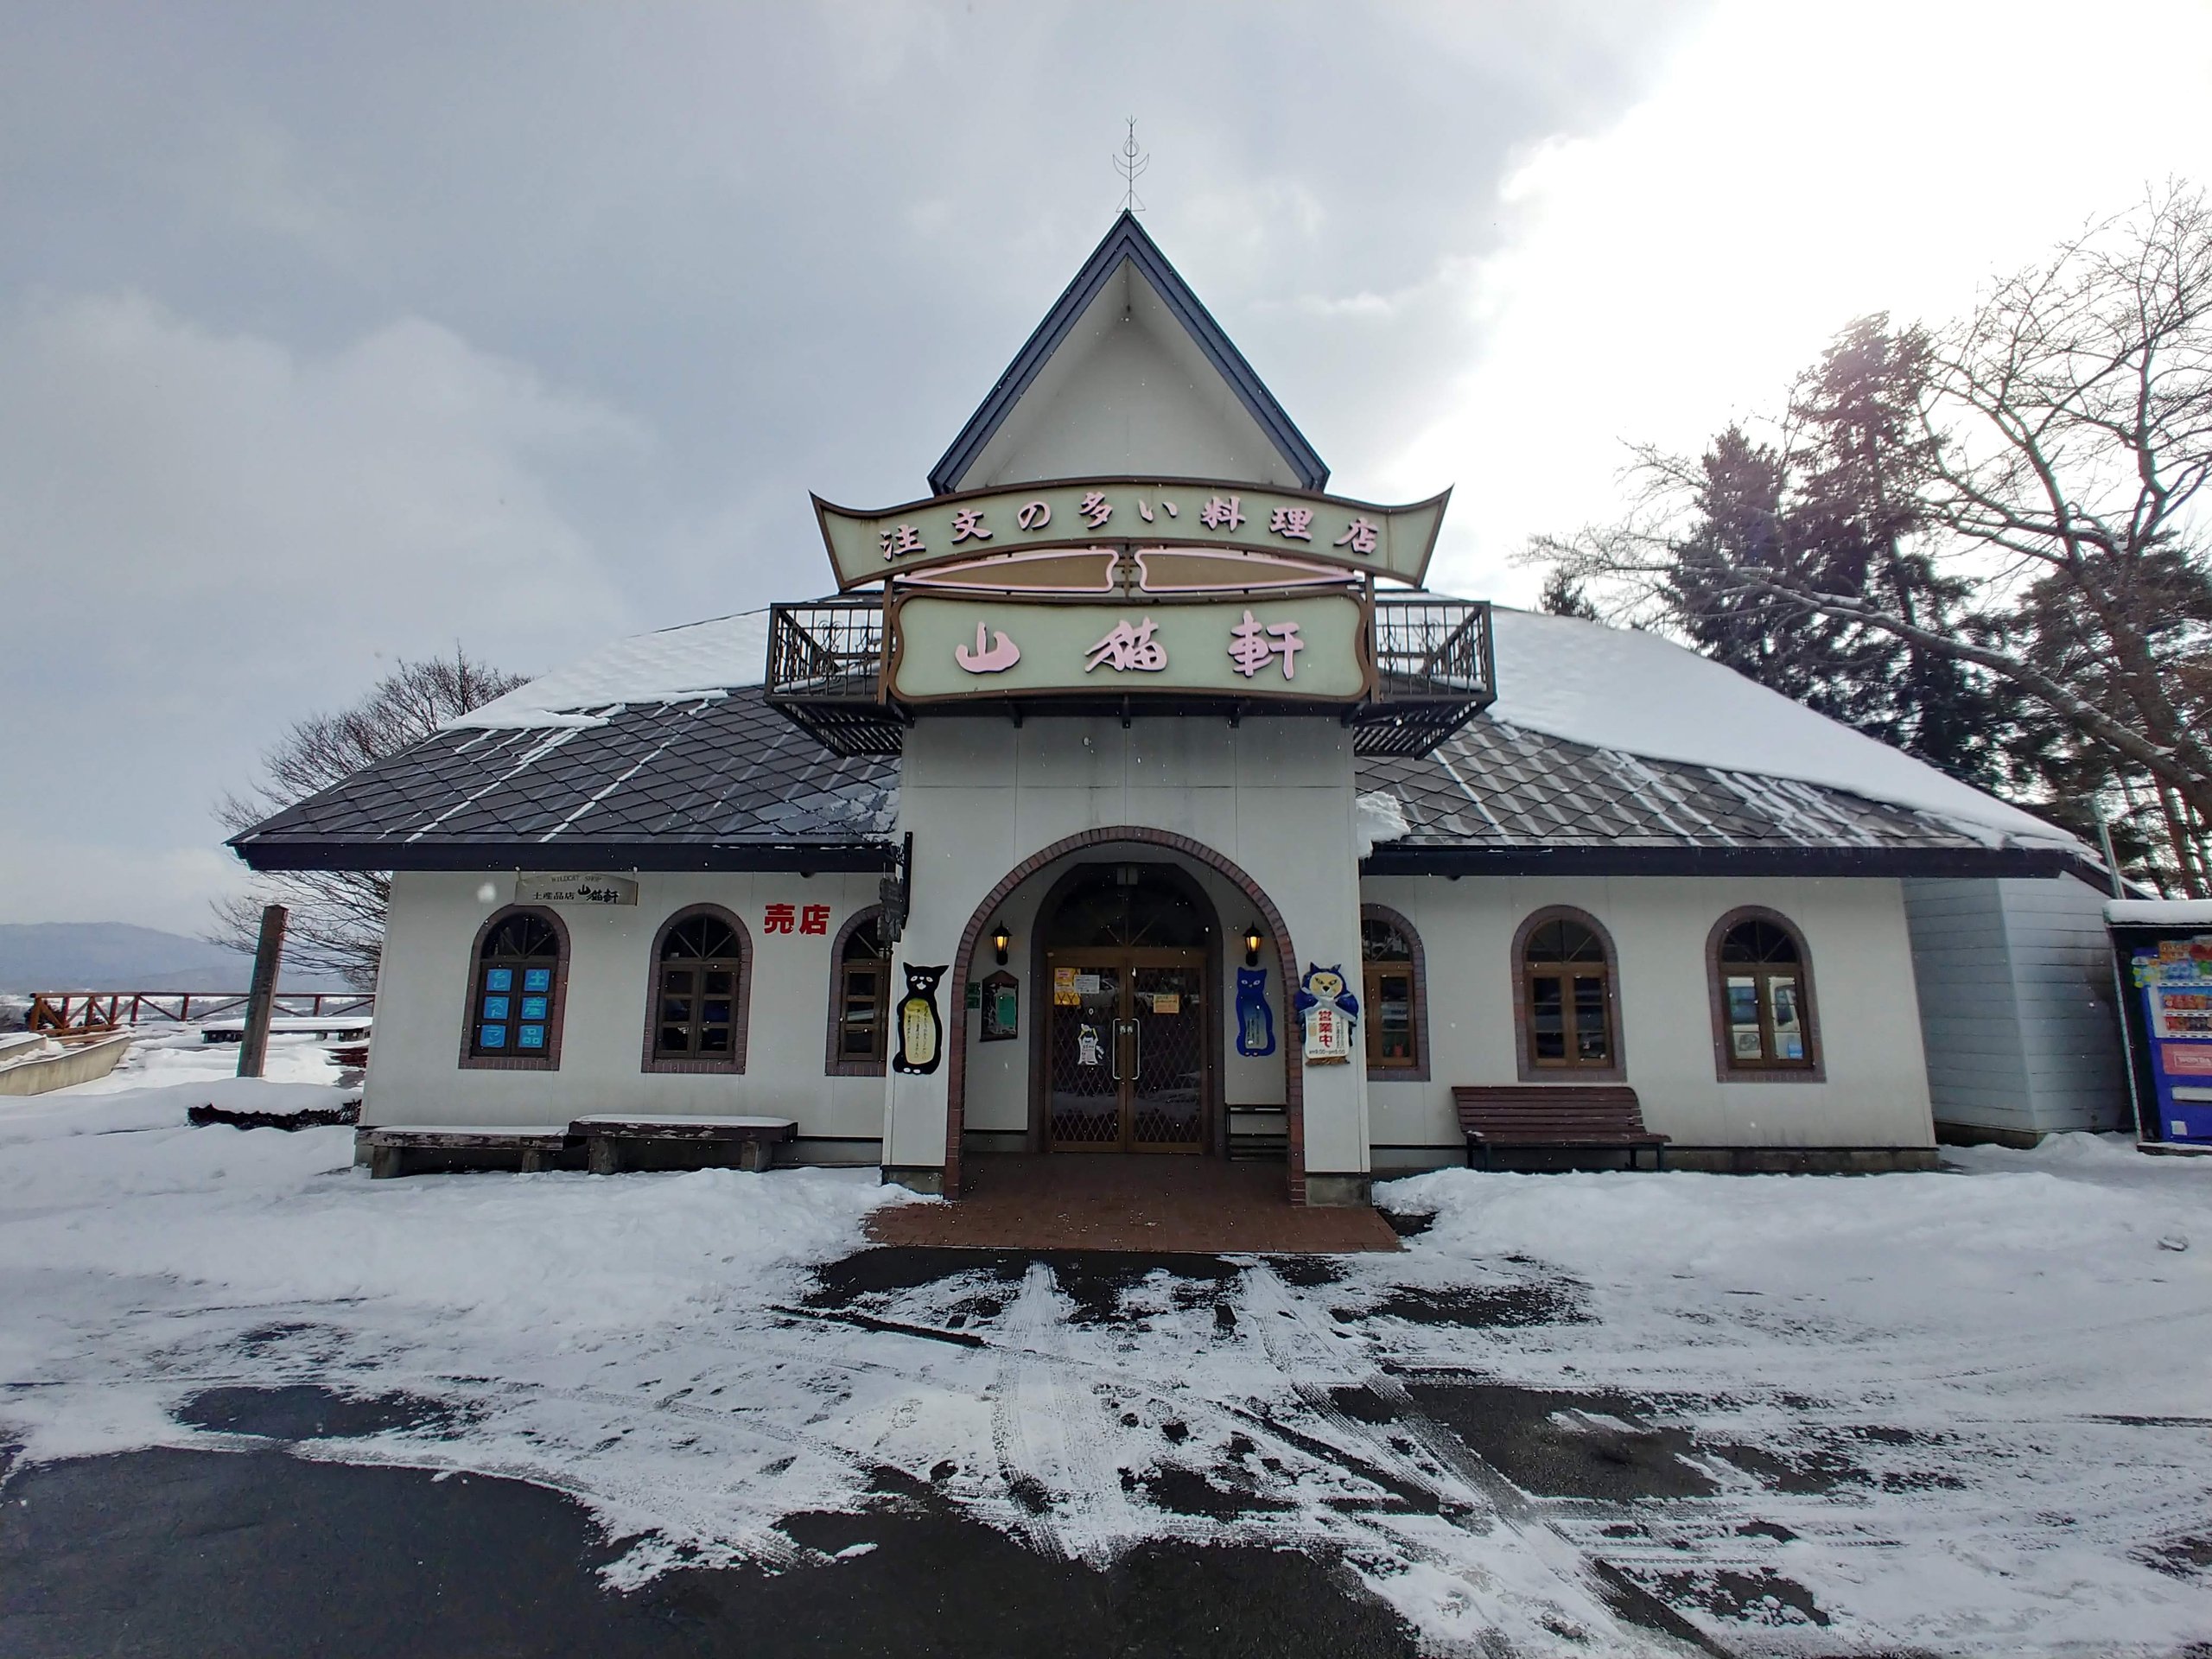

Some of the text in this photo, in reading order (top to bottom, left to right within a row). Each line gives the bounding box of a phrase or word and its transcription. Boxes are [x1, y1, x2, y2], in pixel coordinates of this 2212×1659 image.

[879, 491, 1380, 563] 注文の多い料理店
[955, 609, 1305, 681] 山猫軒
[532, 884, 620, 904] 土産品店 山猫軒
[764, 903, 831, 936] 売店
[1318, 1010, 1333, 1048] 営業中
